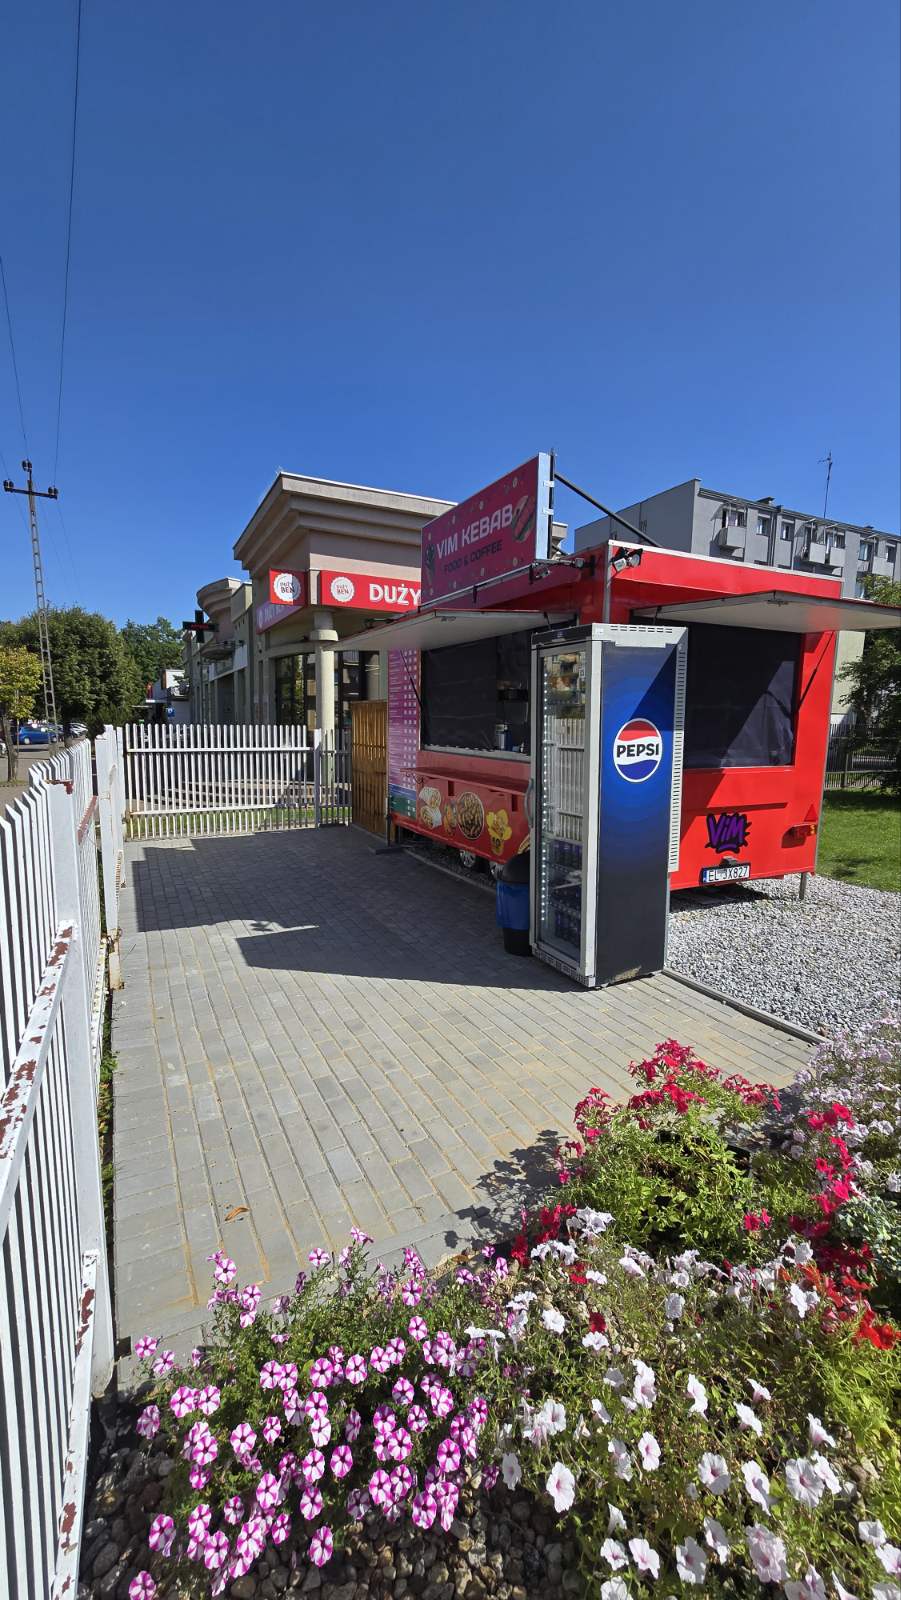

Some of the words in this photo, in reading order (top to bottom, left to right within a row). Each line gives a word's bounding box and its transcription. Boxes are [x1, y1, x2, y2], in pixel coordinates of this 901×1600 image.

[436, 532, 458, 559] VIM
[461, 503, 513, 548] KEBAB
[444, 557, 462, 571] FOOD
[470, 540, 504, 562] COFFEE
[369, 583, 421, 606] DUŻY
[616, 742, 660, 759] PEPSI
[709, 869, 719, 882] EL
